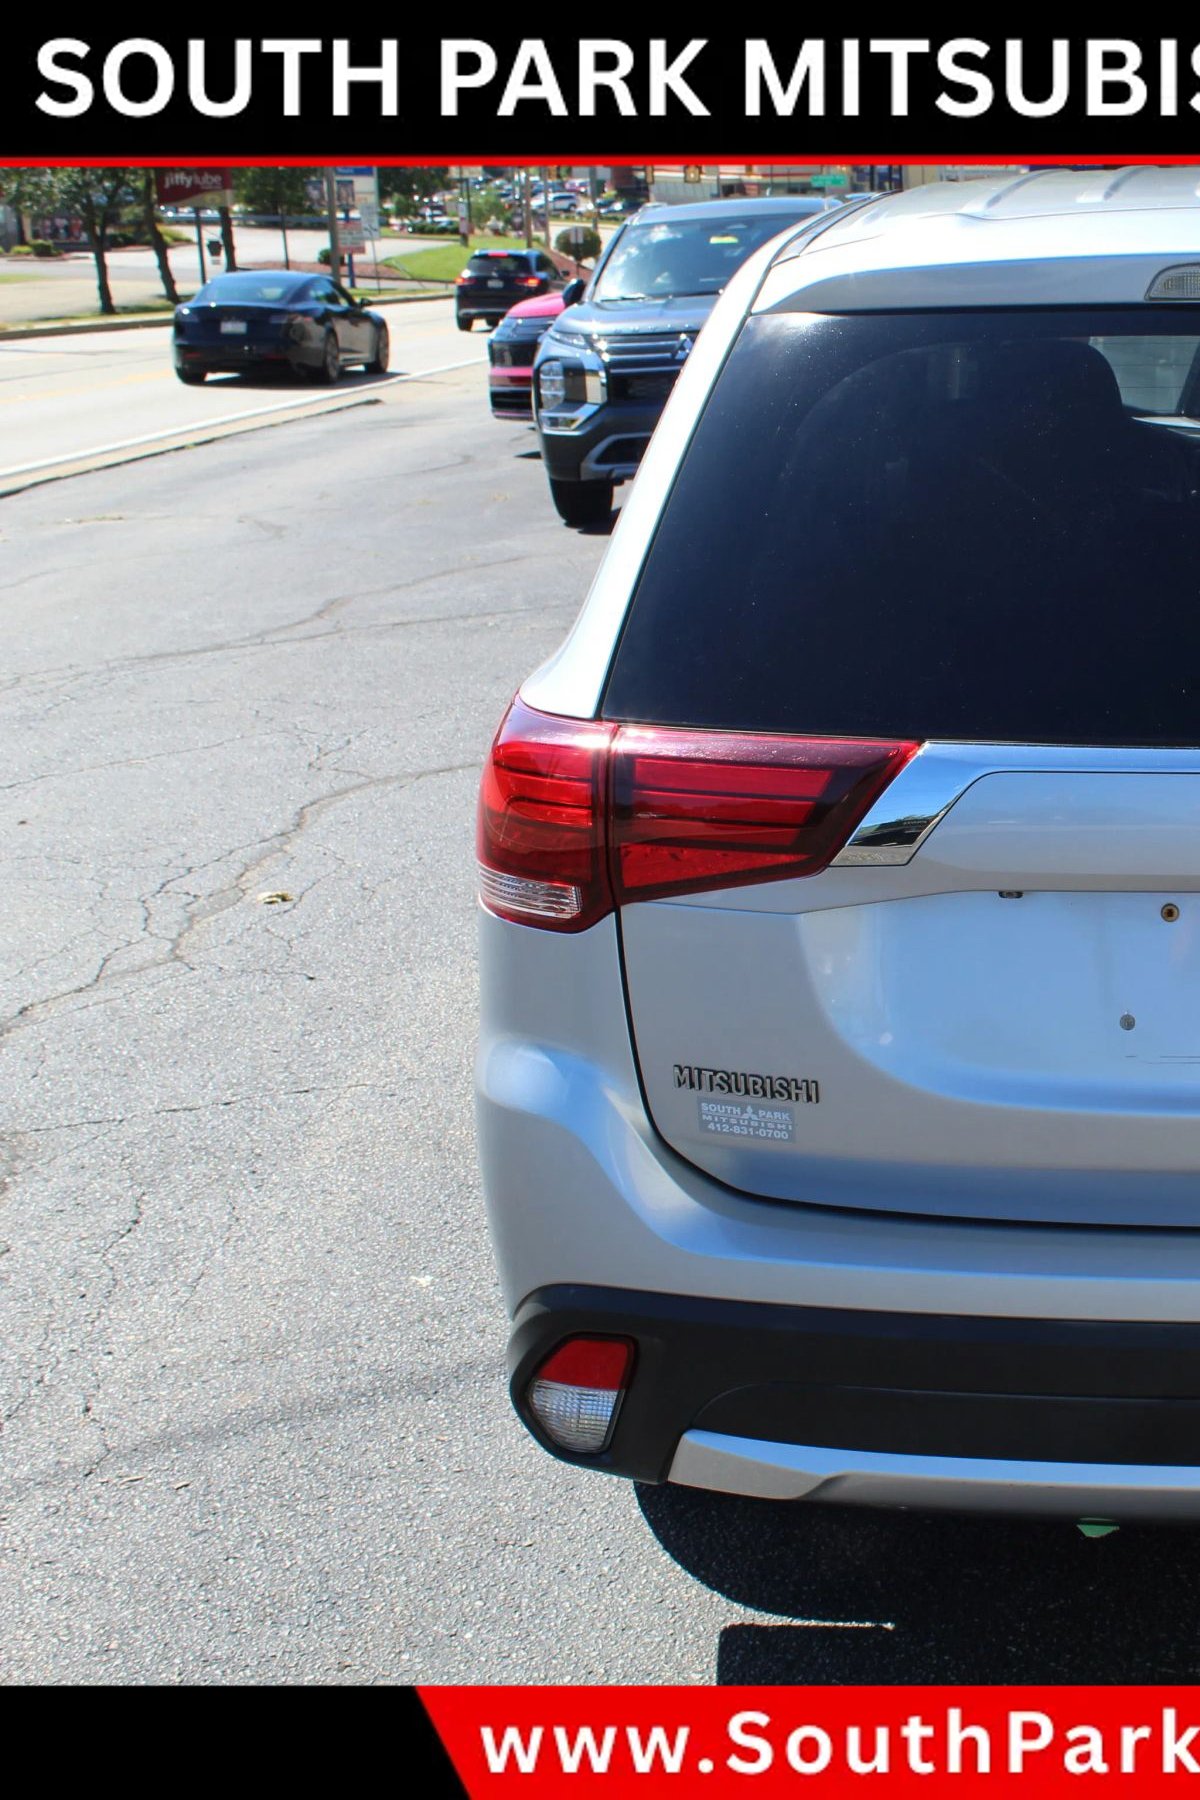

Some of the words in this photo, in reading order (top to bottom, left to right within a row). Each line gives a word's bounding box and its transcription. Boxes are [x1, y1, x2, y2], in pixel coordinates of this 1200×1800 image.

[163, 171, 193, 189] jiffy
[193, 171, 222, 186] lube
[673, 1065, 820, 1104] MITSUBISHI
[701, 1102, 741, 1116] SOUTH
[758, 1109, 791, 1121] PARK
[702, 1114, 793, 1131] MITSUBISHI
[707, 1121, 789, 1140] 412-831-0700
